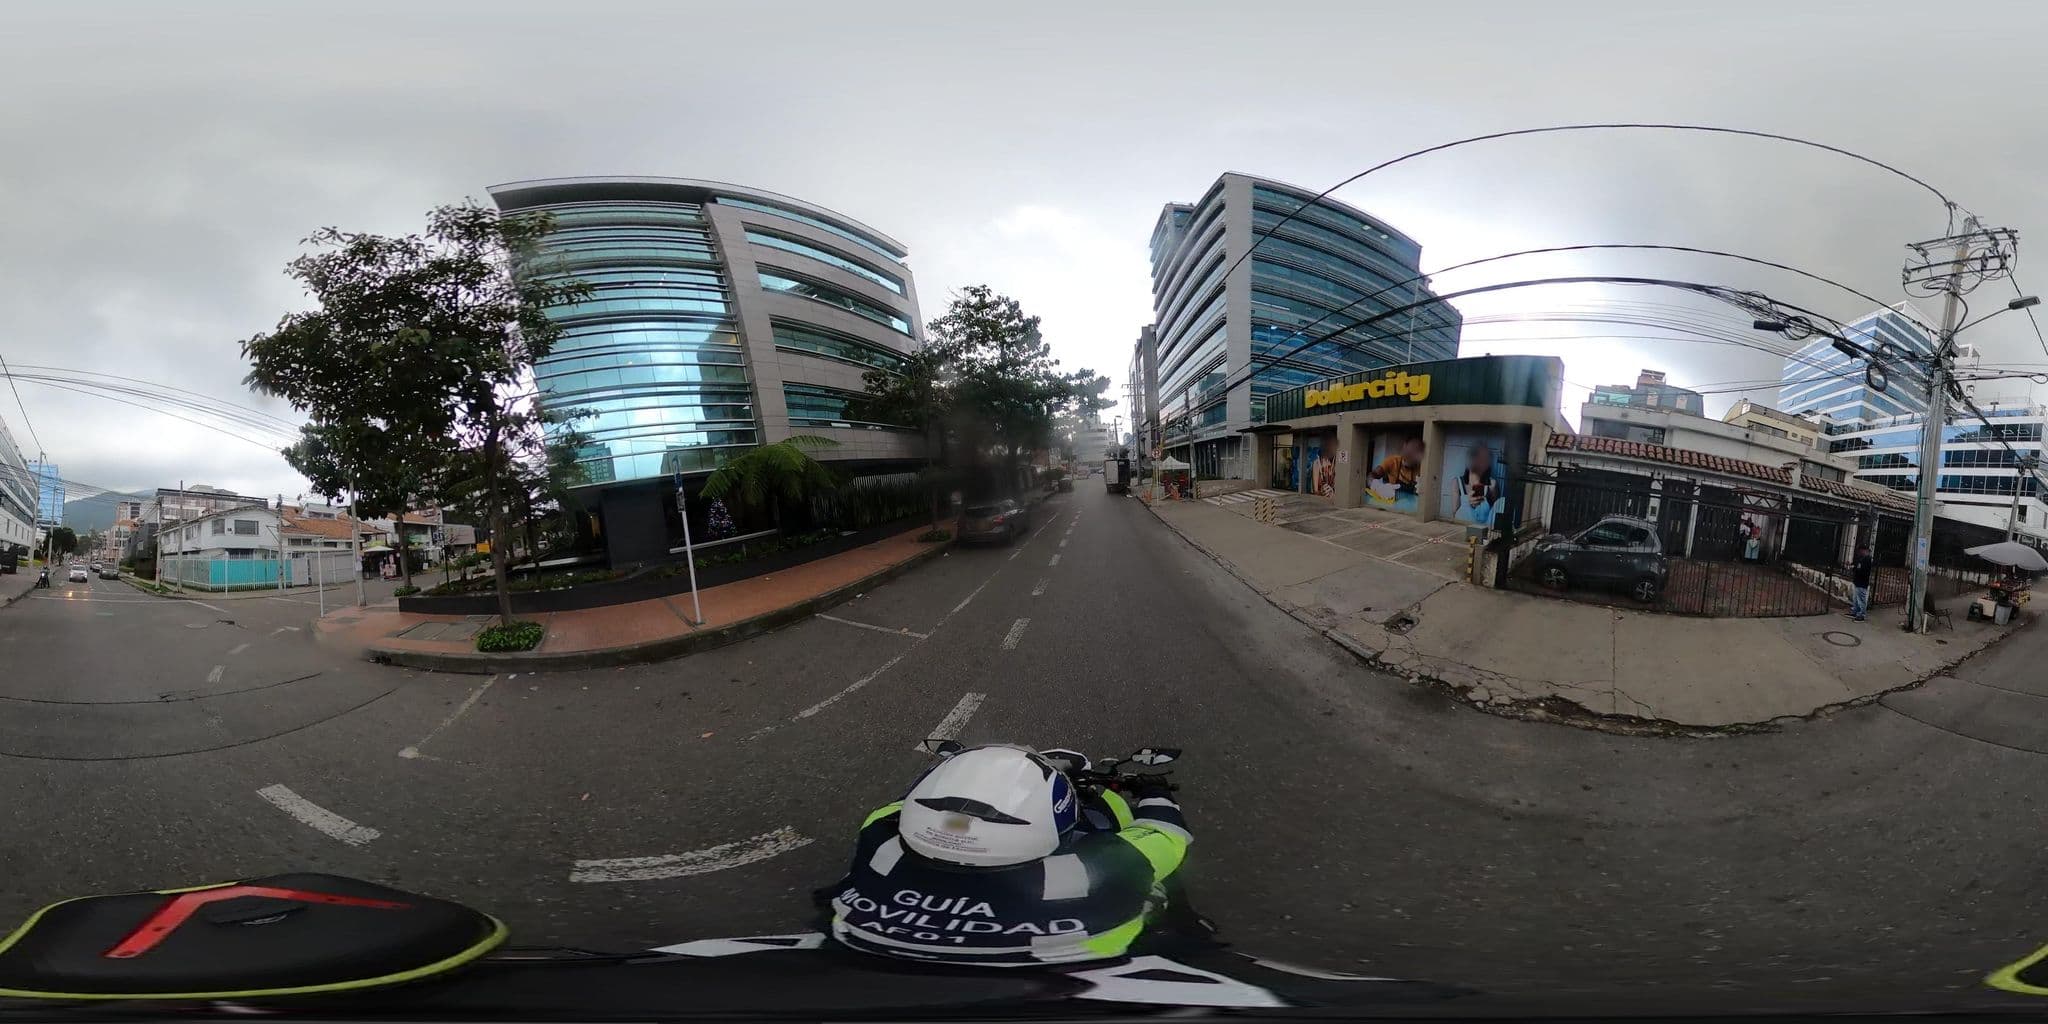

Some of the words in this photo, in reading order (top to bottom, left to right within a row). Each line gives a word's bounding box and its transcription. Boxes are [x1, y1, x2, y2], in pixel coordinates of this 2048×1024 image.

[1305, 371, 1431, 408] Dollarcity
[840, 887, 1084, 935] MOVILIDAD
[893, 889, 996, 918] GUÍA
[860, 921, 965, 944] AF01
